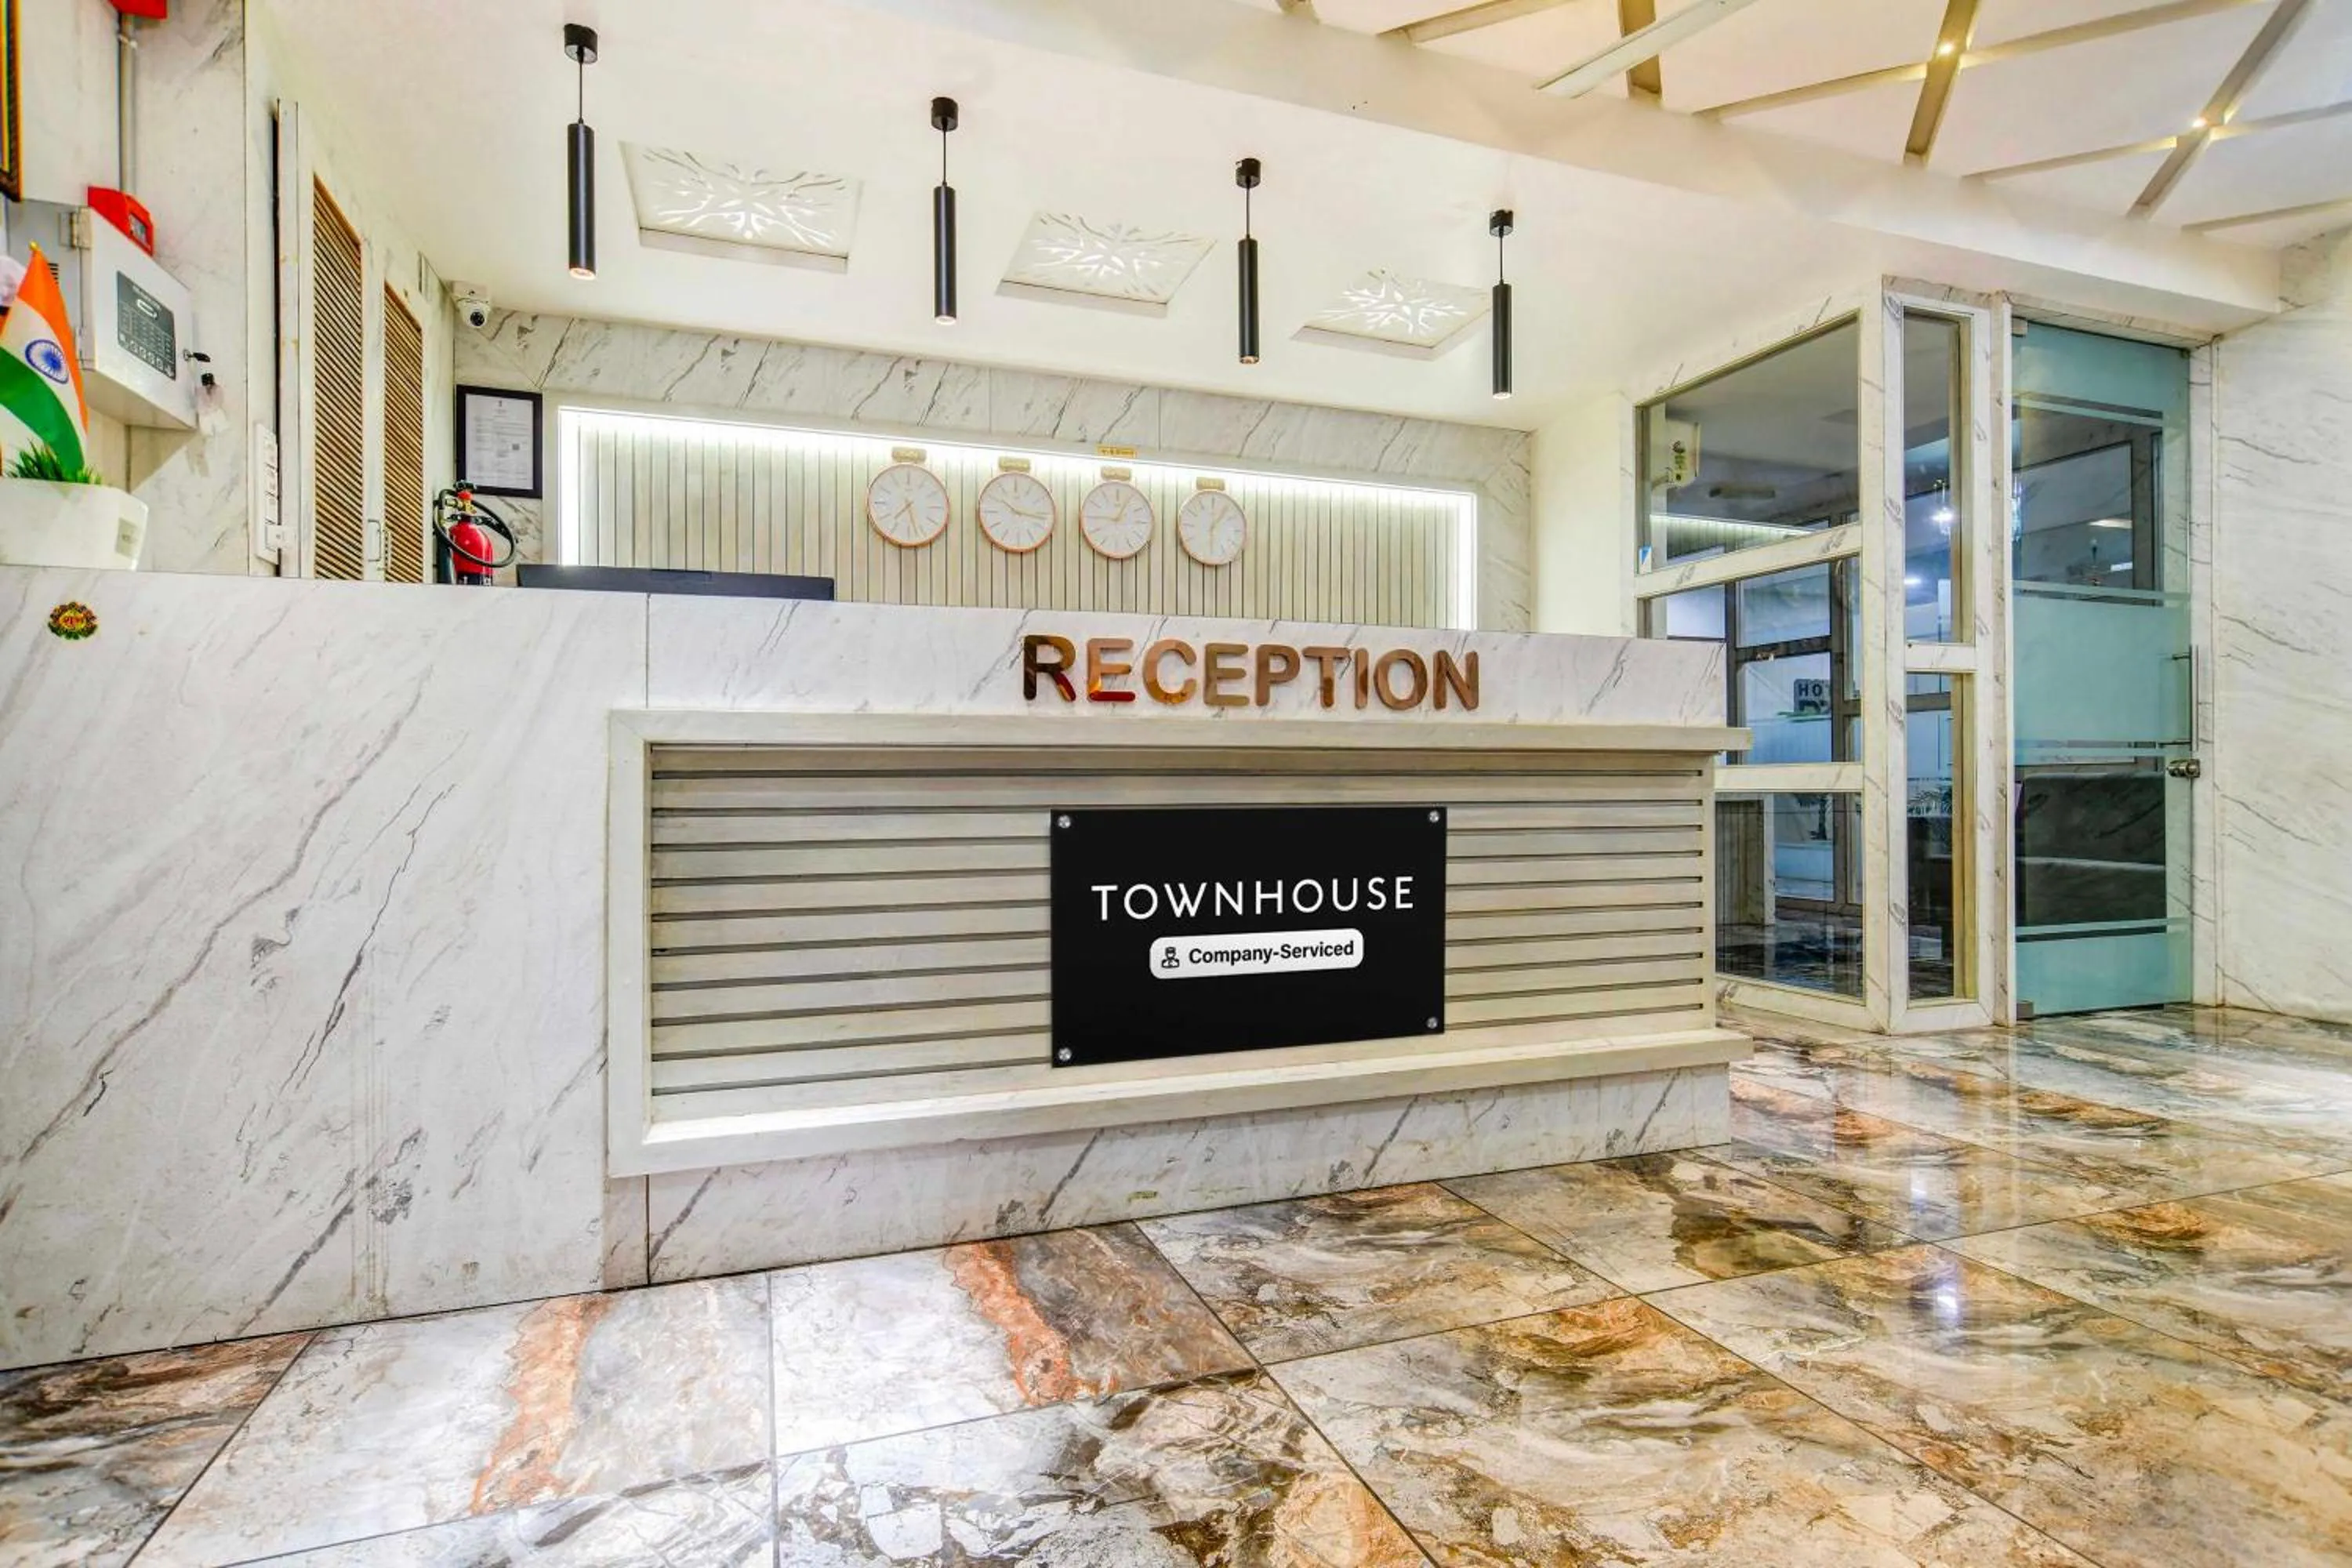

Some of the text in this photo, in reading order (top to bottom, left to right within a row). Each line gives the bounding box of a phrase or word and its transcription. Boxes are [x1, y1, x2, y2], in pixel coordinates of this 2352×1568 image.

[1022, 634, 1479, 710] RECEPTION
[1798, 683, 1829, 697] HO
[1091, 876, 1414, 920] TOWNHOUSE
[1189, 940, 1355, 967] Company-Serviced
